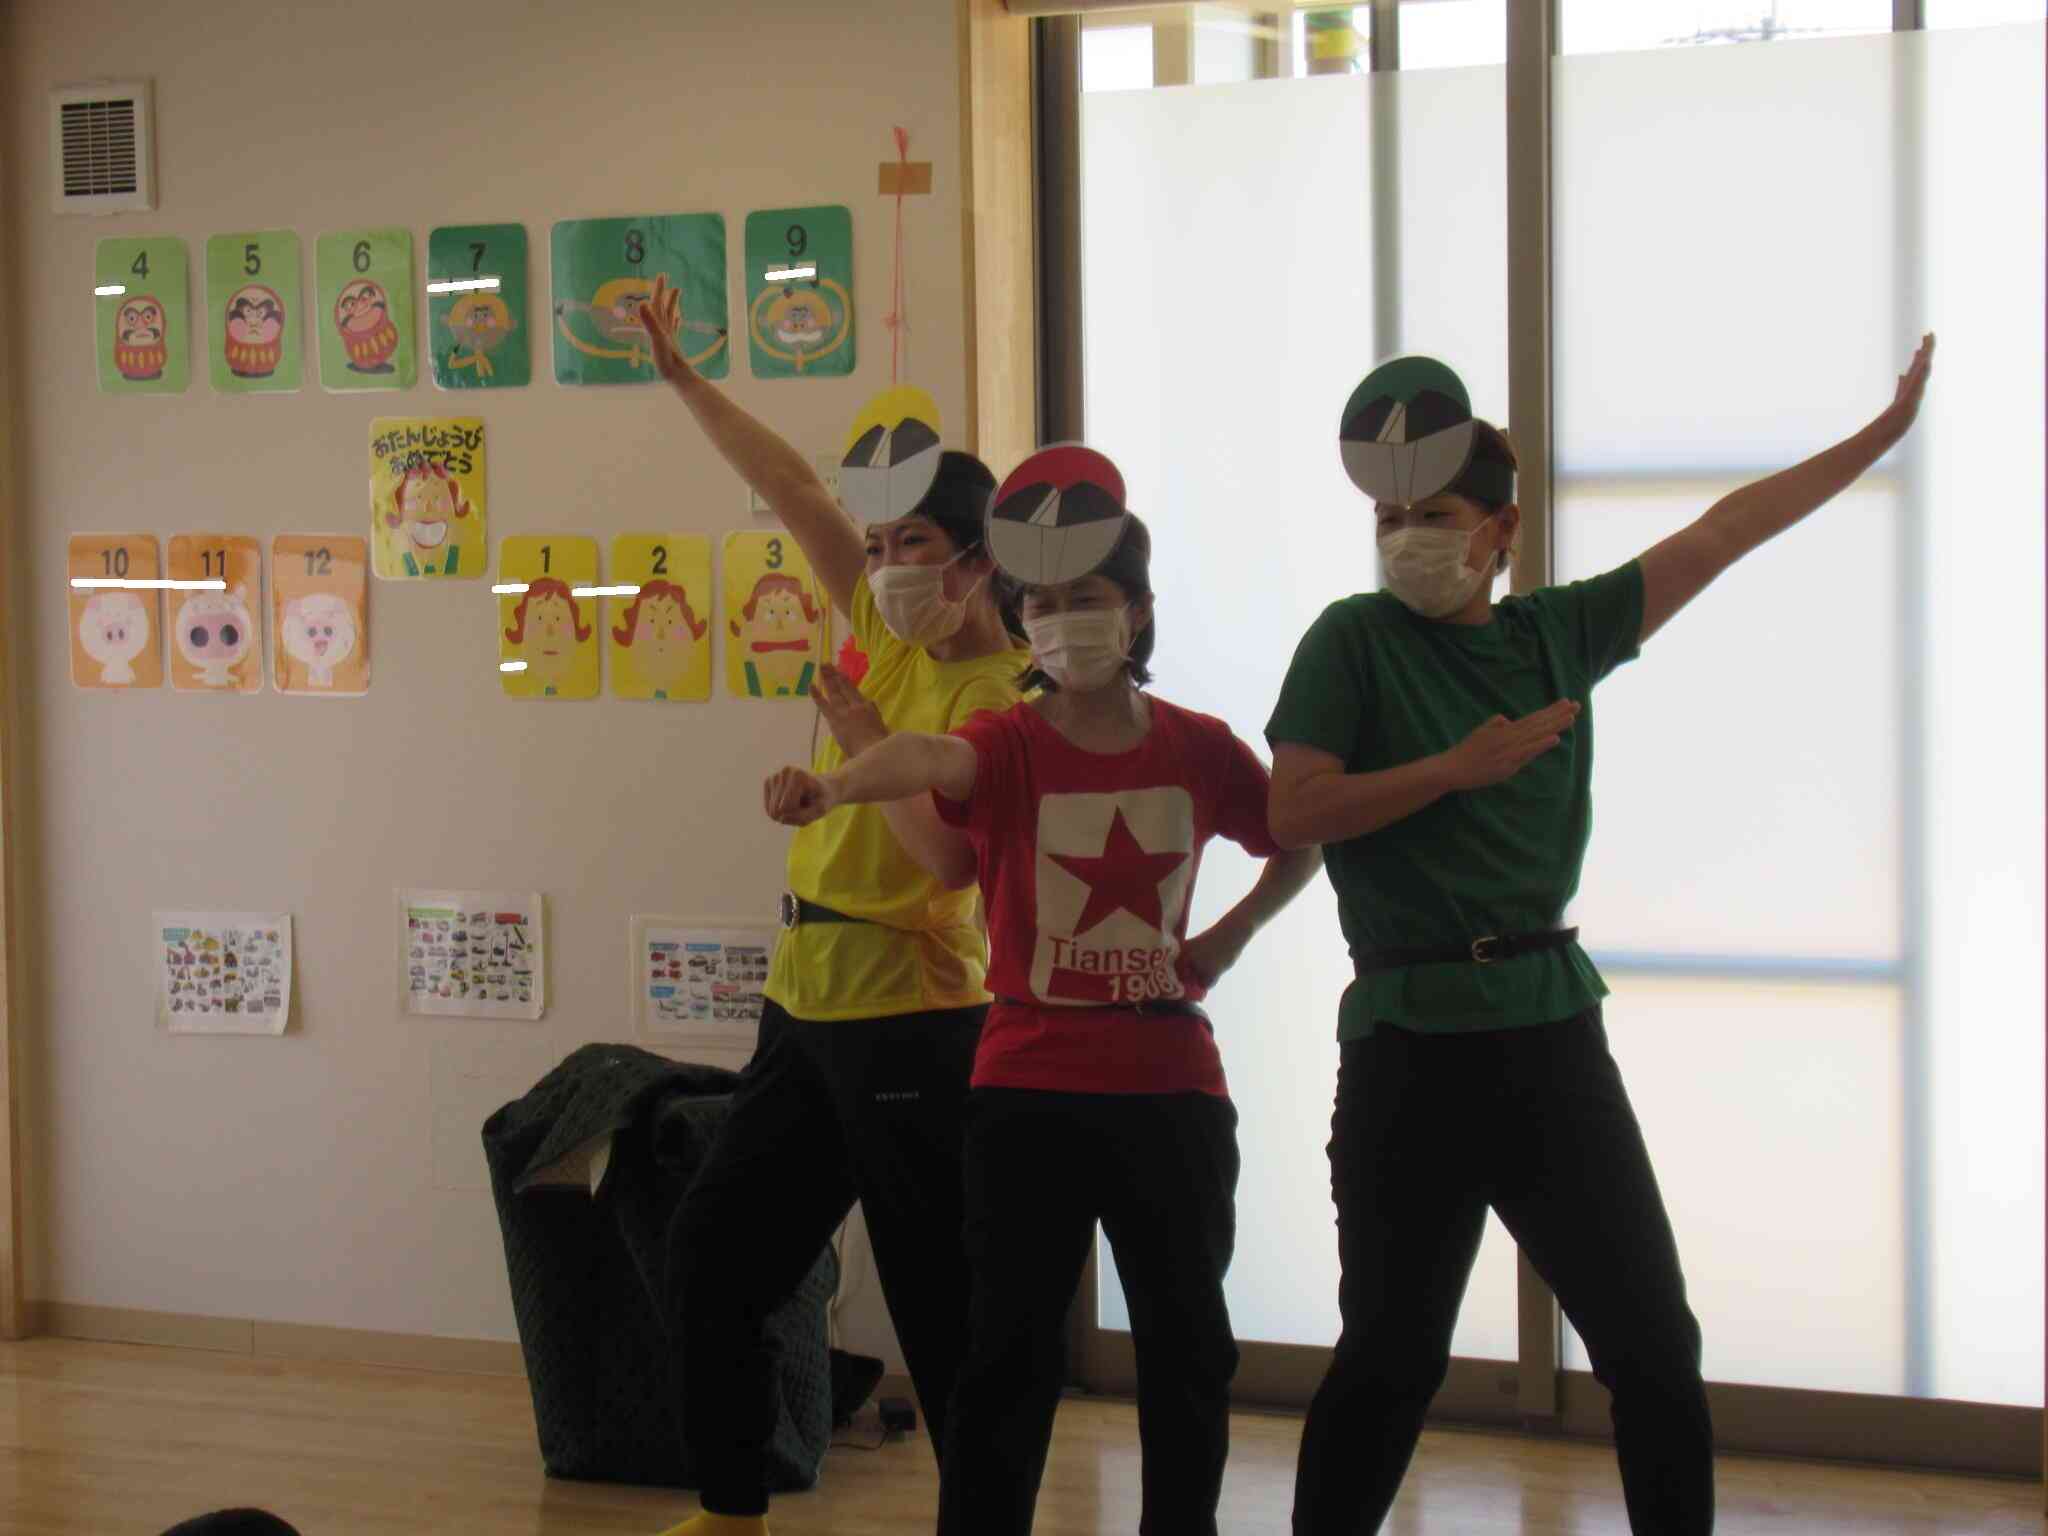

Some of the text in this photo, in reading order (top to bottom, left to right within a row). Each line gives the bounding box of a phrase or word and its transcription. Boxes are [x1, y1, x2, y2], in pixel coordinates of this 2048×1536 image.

[352, 240, 371, 272] 6
[623, 229, 646, 264] 8
[786, 224, 808, 257] 9
[130, 251, 150, 280] 4
[243, 243, 262, 276] 5
[469, 241, 486, 273] 7
[372, 424, 483, 458] おたんじょうび
[390, 449, 473, 476] おめでとう
[101, 547, 130, 577] 10
[201, 549, 226, 577] 11
[303, 547, 332, 577] 12
[540, 545, 551, 573] 1
[651, 545, 668, 574] 2
[765, 537, 783, 569] 3
